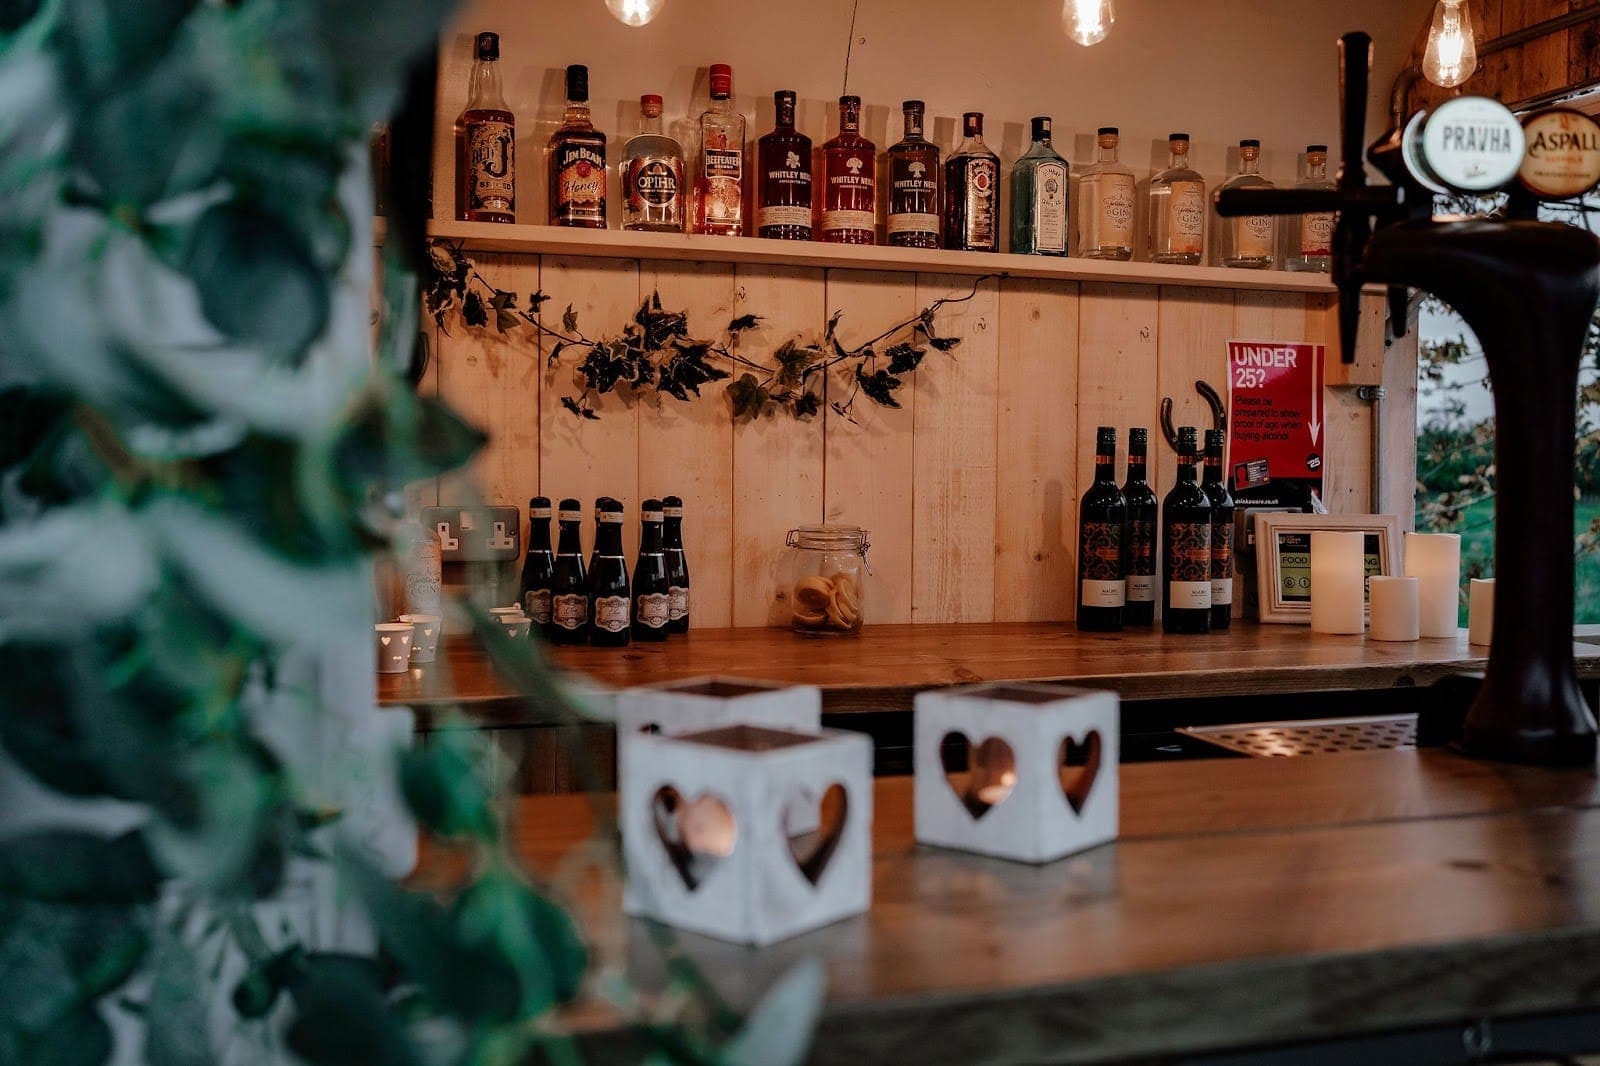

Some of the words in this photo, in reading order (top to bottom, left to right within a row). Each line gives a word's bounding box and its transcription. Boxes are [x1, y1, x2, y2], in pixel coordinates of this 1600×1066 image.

[1442, 125, 1511, 153] PRAVHA
[1529, 131, 1600, 158] ASPALL
[768, 171, 799, 179] WHITLEY
[638, 176, 676, 189] OPIHR
[830, 176, 859, 185] WHITLEY
[894, 179, 922, 188] WHITLEY
[563, 180, 598, 194] Honey
[1112, 208, 1128, 216] GIN
[1251, 218, 1268, 226] GIN
[1234, 346, 1297, 368] UNDER
[1235, 368, 1266, 388] 25?
[1234, 409, 1269, 419] prepared
[1271, 409, 1278, 417] to
[1280, 409, 1301, 418] show
[1234, 421, 1255, 431] proof
[1256, 421, 1263, 429] of
[1234, 432, 1261, 442] buying
[1282, 556, 1308, 564] FOOD
